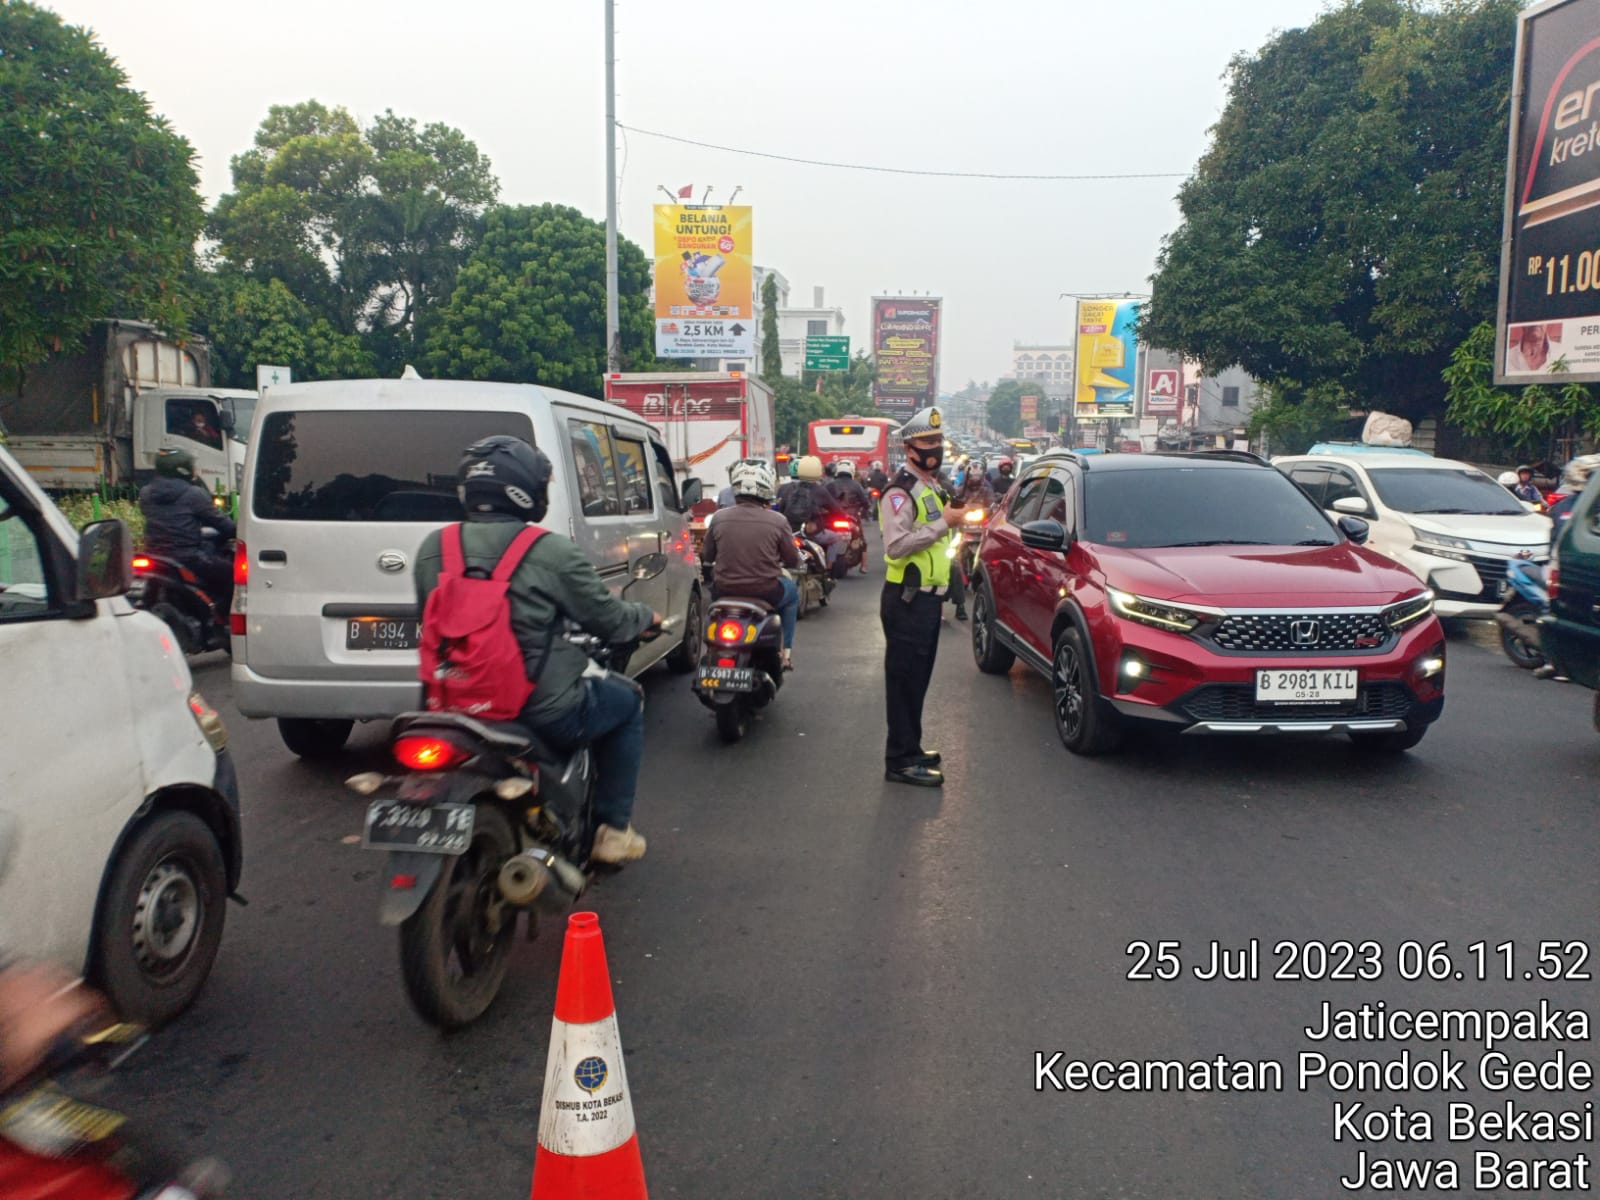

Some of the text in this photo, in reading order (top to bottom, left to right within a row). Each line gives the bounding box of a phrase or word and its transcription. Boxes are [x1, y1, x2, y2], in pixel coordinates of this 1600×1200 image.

[675, 224, 732, 235] UNTUNG!
[683, 324, 701, 337] 2,5
[704, 324, 725, 336] KM
[350, 622, 360, 639] B
[370, 622, 406, 639] 1394
[1260, 672, 1355, 690] B 2981 KIL
[555, 1100, 581, 1111] DISHUB
[582, 1099, 602, 1110] KOTA
[591, 1109, 608, 1121] 2022
